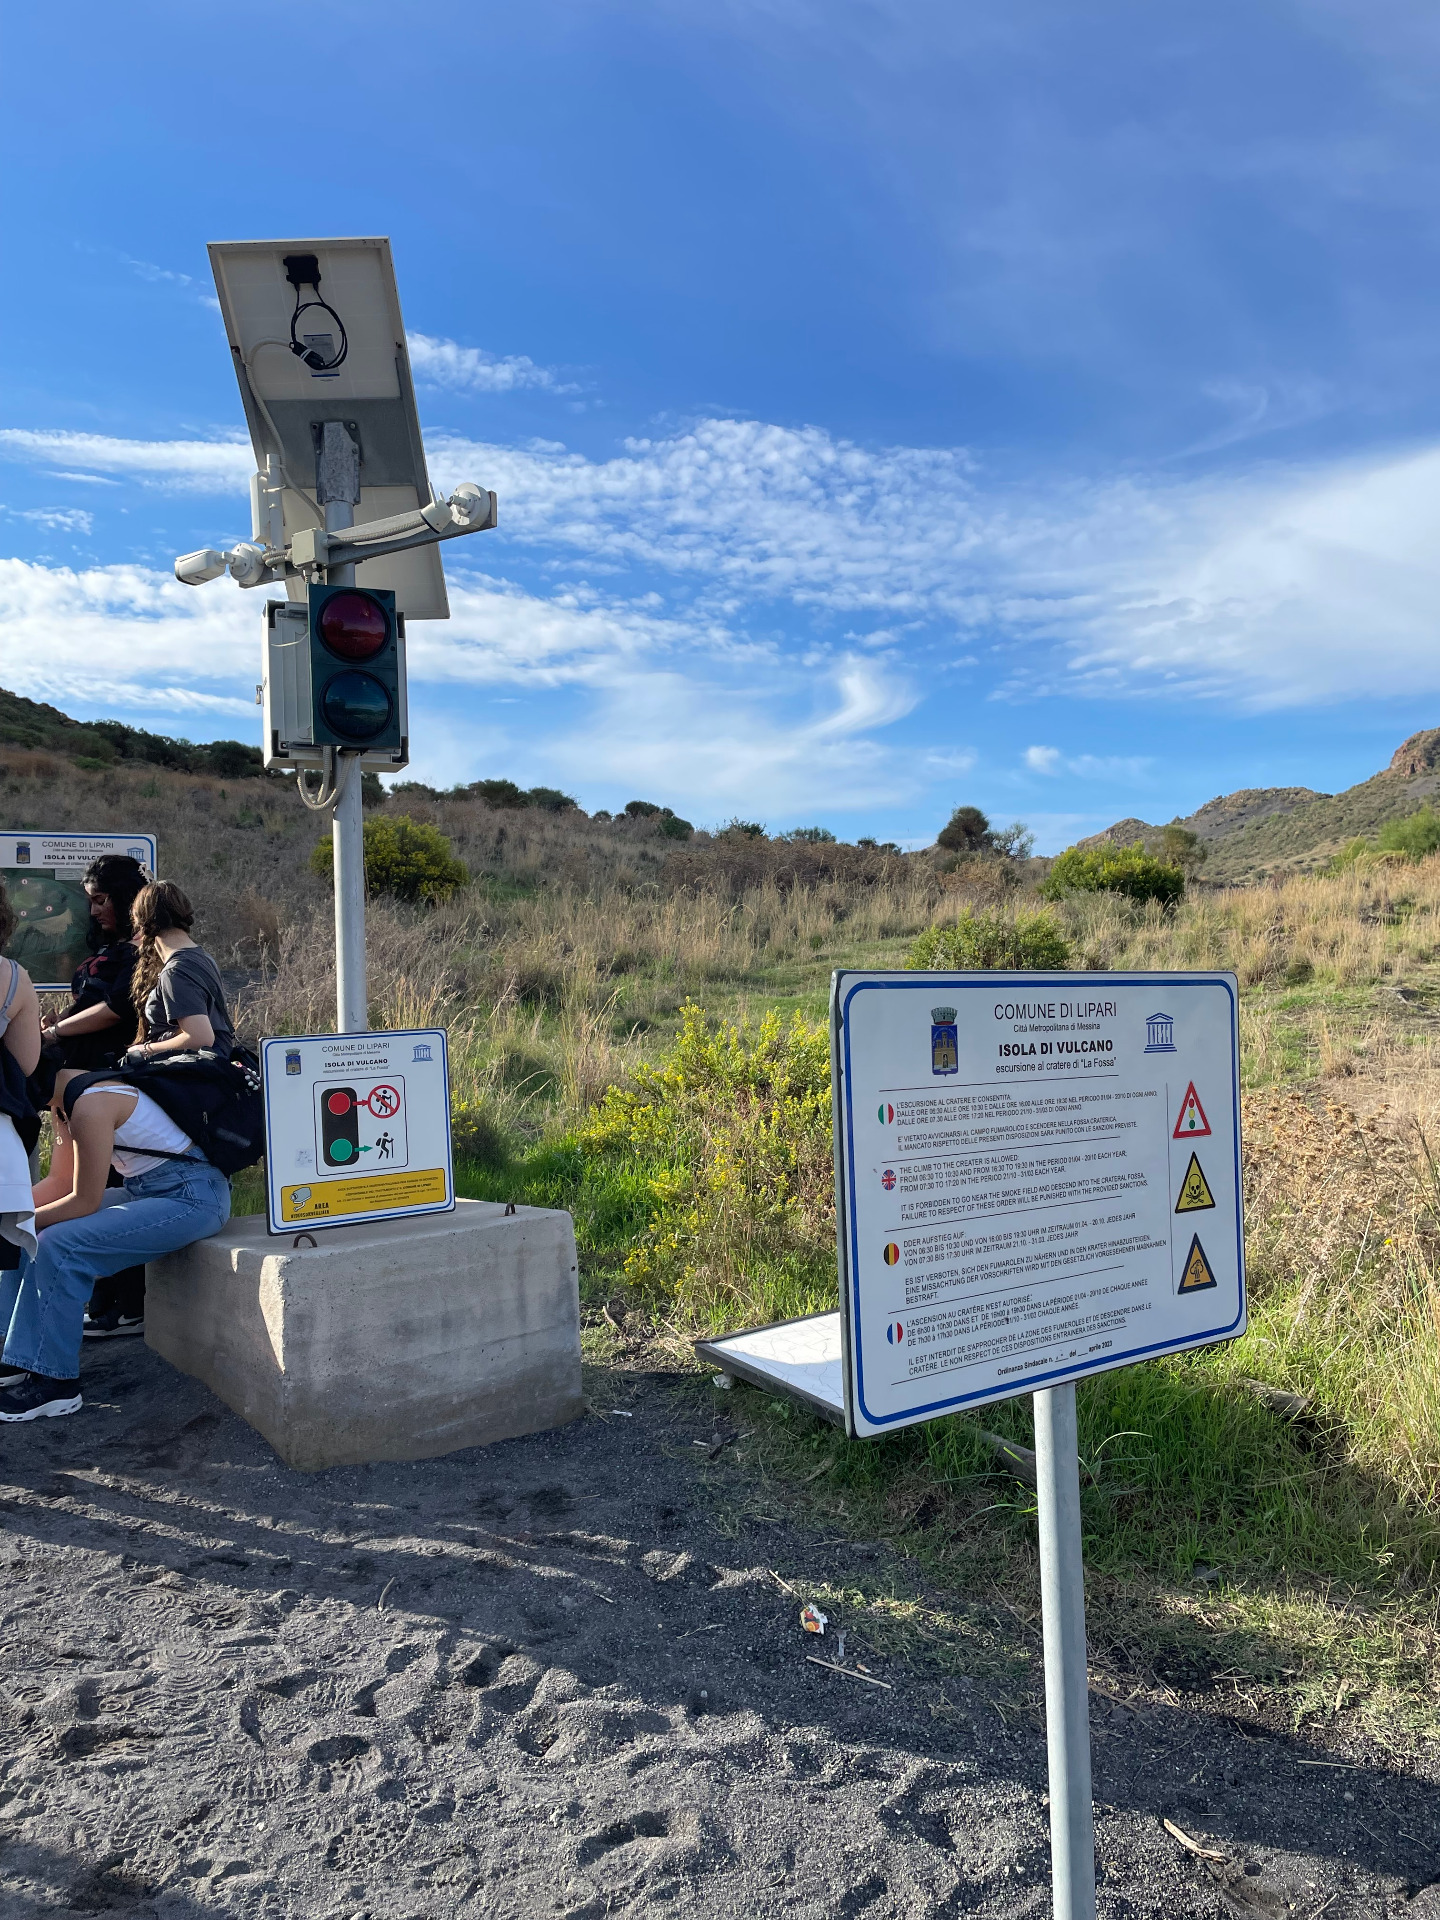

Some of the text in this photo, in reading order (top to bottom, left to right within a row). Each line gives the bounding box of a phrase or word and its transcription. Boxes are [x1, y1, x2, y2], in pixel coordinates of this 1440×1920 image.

[995, 1002, 1117, 1020] COMUNE DI LIPARI
[1013, 1024, 1028, 1033] Città
[1029, 1024, 1069, 1032] Metropolitana
[322, 1044, 356, 1052] COMUNE
[367, 1042, 390, 1050] LIPARI
[999, 1040, 1113, 1057] ISOLA DI VULCANO
[996, 1064, 1036, 1073] escursione
[1037, 1063, 1044, 1071] al
[1046, 1062, 1071, 1070] cratere
[1073, 1061, 1079, 1069] di
[896, 1110, 915, 1118] DALLE
[916, 1108, 928, 1116] ORE
[944, 1106, 957, 1114] ALLE
[989, 1102, 1005, 1110] DALLE
[946, 1097, 971, 1105] CRATERE
[898, 1118, 915, 1126] DALLE
[944, 1114, 957, 1122] ALLE
[995, 1109, 1019, 1117] PERIODO
[904, 1134, 927, 1142] VIETATO
[928, 1130, 962, 1140] AVVICINARSI
[970, 1128, 990, 1136] CAMPO
[1057, 1120, 1073, 1128] NELLA
[904, 1124, 1114, 1151] MANCATO RISPETTO DELLE PRESENTI PUNITO SANZIONI
[900, 1166, 912, 1174] THE
[913, 1164, 932, 1173] CLIMB
[943, 1161, 954, 1169] THE
[956, 1158, 983, 1168] CREATER
[984, 1157, 990, 1165] IS
[900, 1175, 918, 1184] FROM
[960, 1168, 972, 1176] AND
[973, 1166, 990, 1174] FROM
[900, 1184, 918, 1193] FROM
[968, 1176, 979, 1184] THE
[980, 1173, 1002, 1183] PERIOD
[901, 1183, 1118, 1221] FAILURE RESPECT OF THESE WILL PUNISHED WITH THE PROVIDED
[915, 1198, 951, 1210] FORBIDDEN
[961, 1195, 970, 1203] GO
[972, 1193, 988, 1202] NEAR
[989, 1191, 1000, 1199] THE
[1001, 1188, 1021, 1198] SMOKE
[1022, 1186, 1038, 1195] FIELD
[1051, 1181, 1076, 1191] DESCEND
[1077, 1179, 1089, 1187] INTO
[1090, 1178, 1100, 1186] THE
[904, 1248, 917, 1257] VON
[934, 1243, 944, 1252] BIS
[961, 1239, 973, 1248] UND
[1003, 1232, 1012, 1241] BIS
[1048, 1222, 1074, 1233] ZEITRAUM
[1107, 1214, 1122, 1224] JEDES
[1123, 1212, 1135, 1220] JAHR
[922, 1233, 952, 1245] AUFSTIEG
[904, 1258, 917, 1267] VON
[935, 1253, 945, 1262] BIS
[961, 1248, 974, 1256] UHR
[983, 1241, 1012, 1253] ZEITRAUM
[1047, 1232, 1064, 1242] JEDES
[906, 1252, 1094, 1295] EINE MISSACHTUNG DER VORSCHRIFTEN WIRD MIT DEN GESETZLICH
[915, 1242, 1107, 1284] IST SICH DEN FUMAROLEN UND KRATER
[954, 1282, 1130, 1327] DANS DANS CHAQUE
[954, 1326, 970, 1336] DANS
[1038, 1306, 1060, 1318] CHAQUE
[915, 1354, 927, 1364] EST
[928, 1348, 956, 1361] INTERDIT
[1025, 1328, 1040, 1338] ZONE
[1041, 1325, 1052, 1335] DES
[1053, 1318, 1085, 1332] FUMEROLES
[1100, 1307, 1130, 1320] DESCENDRE
[1131, 1304, 1145, 1313] DANS
[949, 1334, 1052, 1366] NON RESPECT CES DISPOSITIONS
